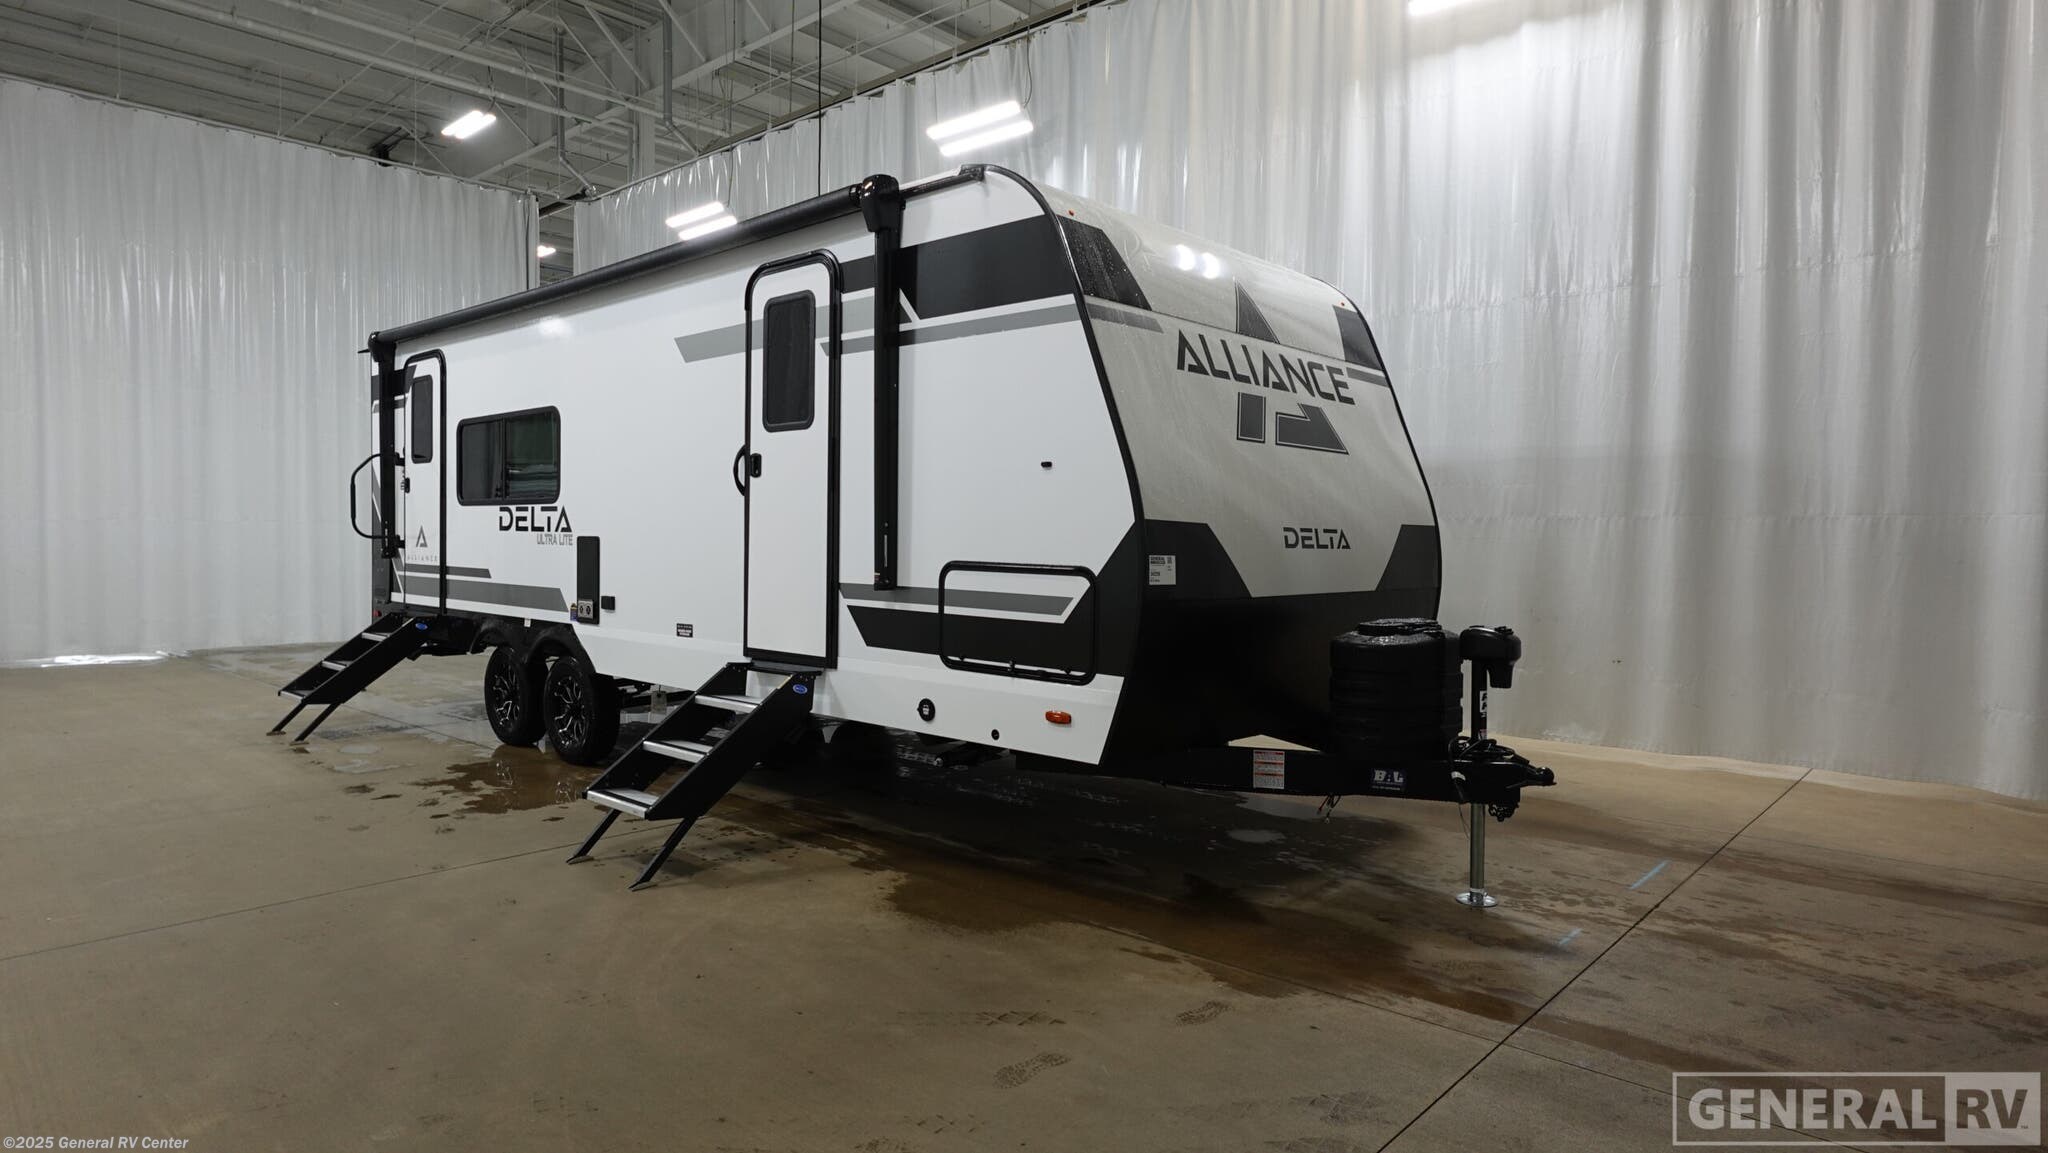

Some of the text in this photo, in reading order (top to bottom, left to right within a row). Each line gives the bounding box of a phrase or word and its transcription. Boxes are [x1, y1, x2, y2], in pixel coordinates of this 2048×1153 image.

[1177, 329, 1356, 405] ALLIANCE
[499, 505, 573, 532] DELTA
[536, 533, 573, 545] ULTRA LITE
[1283, 527, 1351, 549] DELTA
